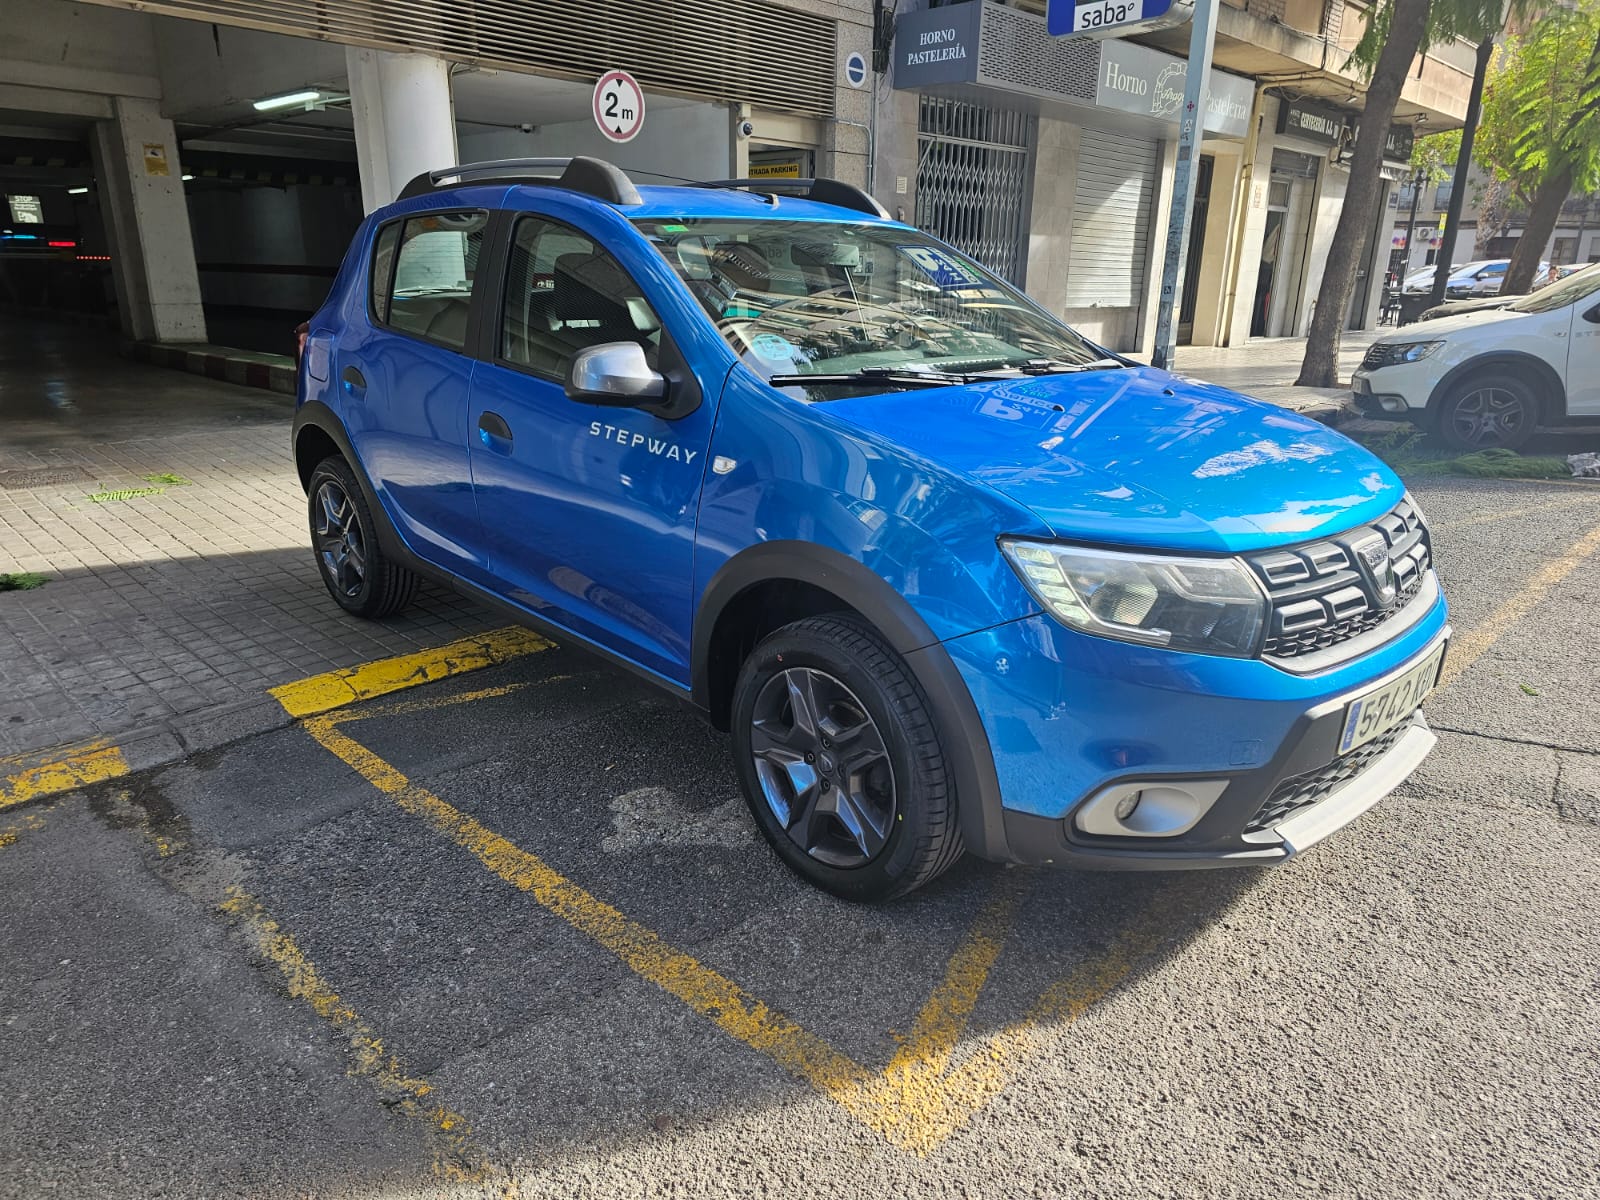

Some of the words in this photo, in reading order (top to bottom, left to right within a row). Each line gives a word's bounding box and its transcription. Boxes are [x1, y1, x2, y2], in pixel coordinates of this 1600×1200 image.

[920, 28, 956, 46] HORNO
[906, 43, 967, 66] PASTELERÍA
[1105, 60, 1147, 96] Horno
[605, 91, 618, 118] 2
[621, 108, 634, 121] m
[770, 164, 798, 174] PARKING
[589, 421, 697, 465] STEPWAY
[1359, 679, 1411, 738] 5742
